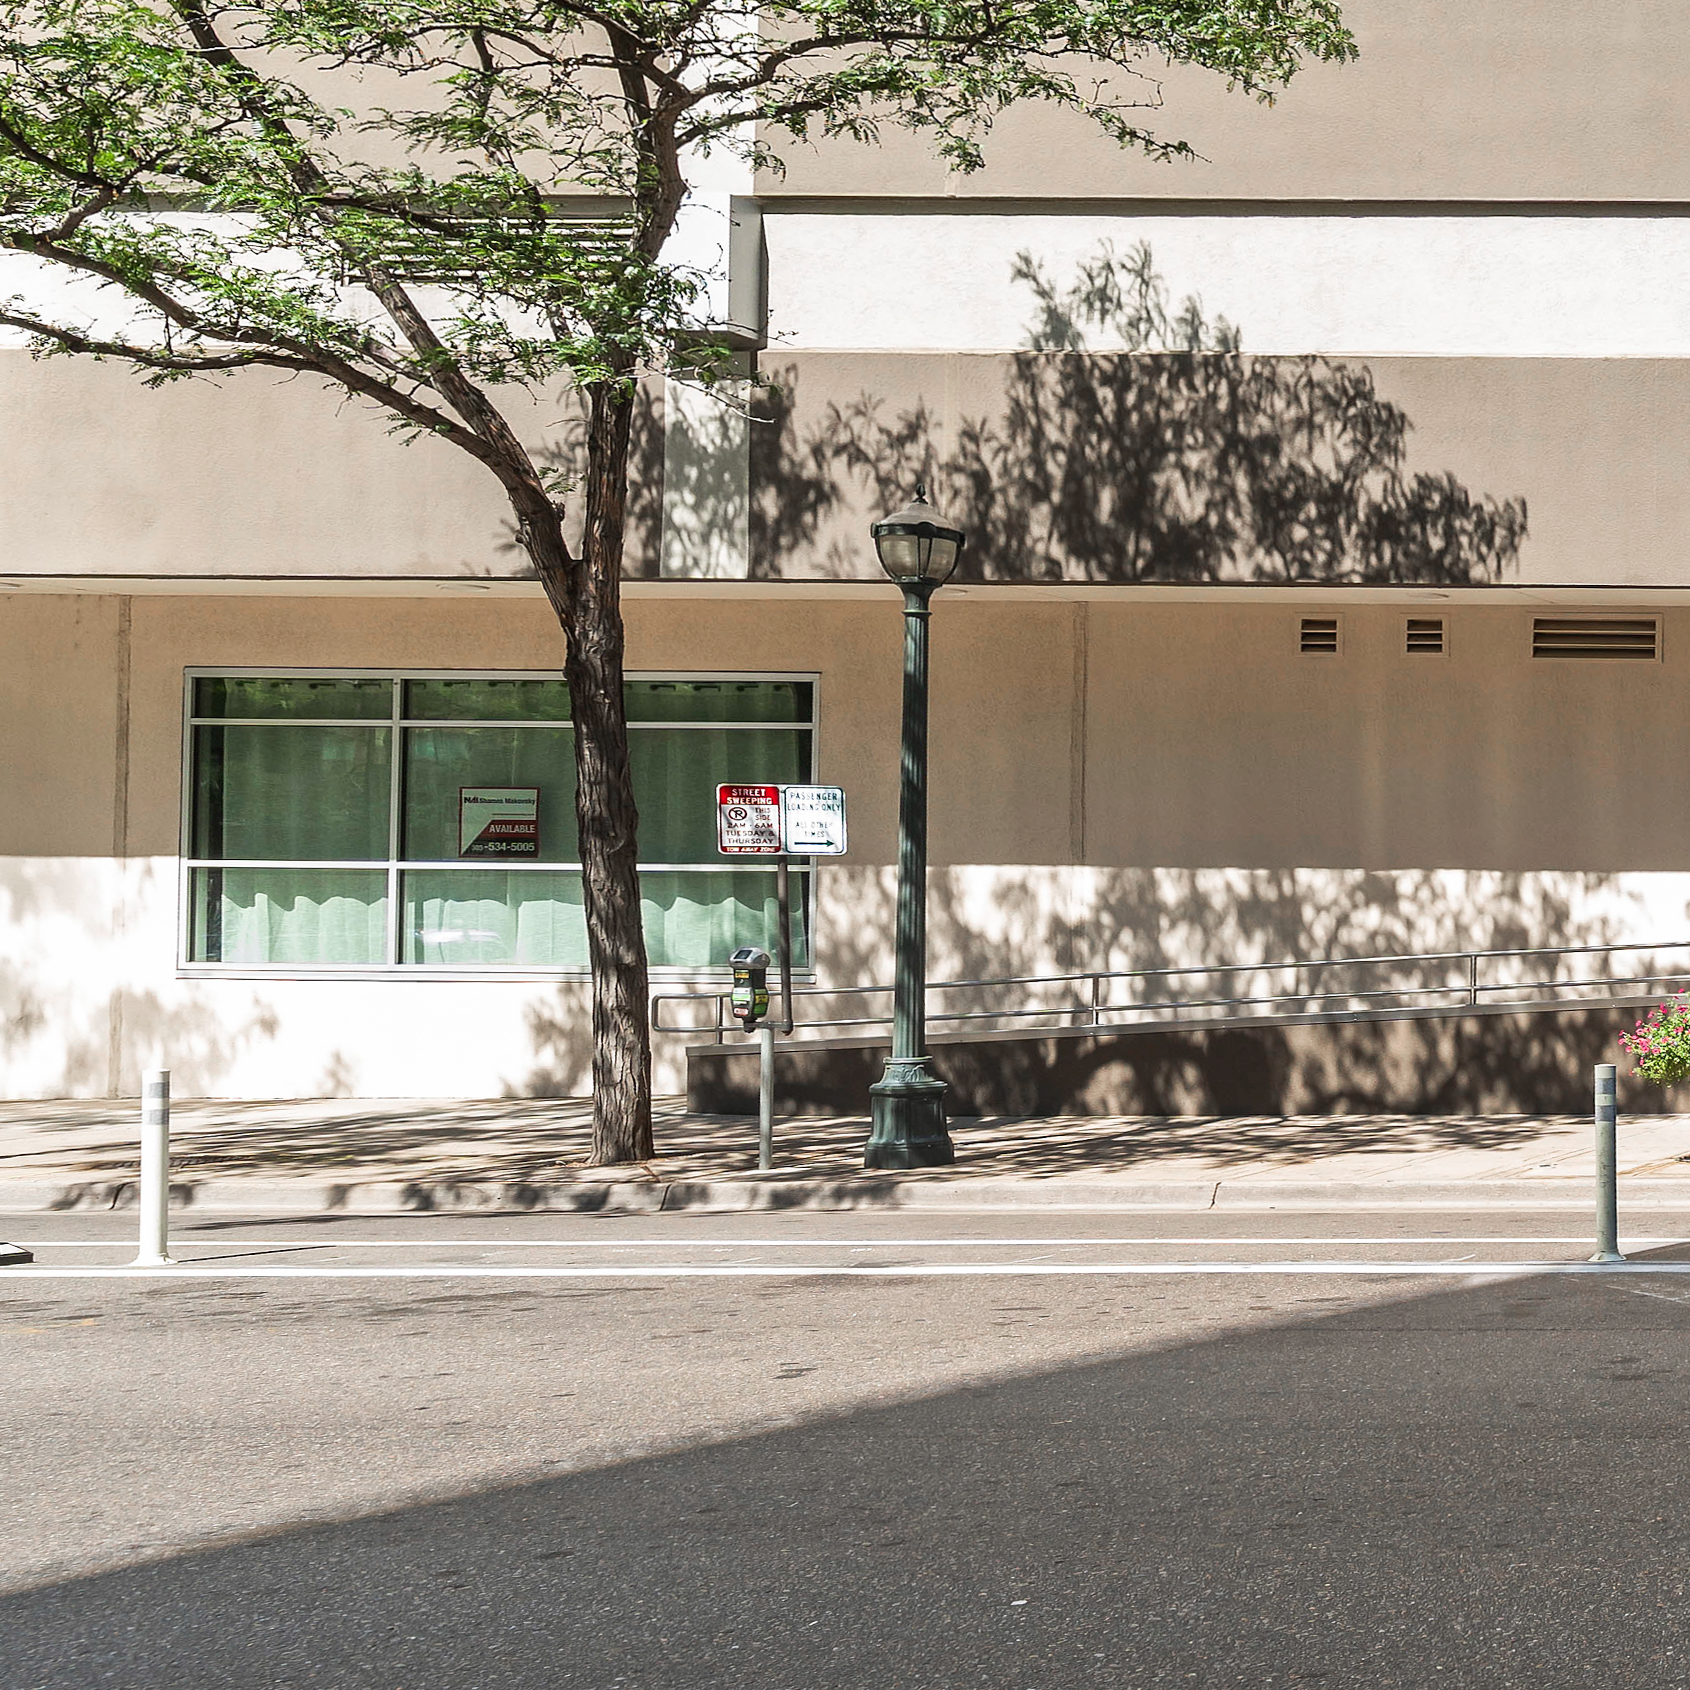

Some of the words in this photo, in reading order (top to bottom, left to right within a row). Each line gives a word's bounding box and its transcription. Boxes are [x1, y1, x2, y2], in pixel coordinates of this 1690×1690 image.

[732, 788, 766, 796] STREET
[790, 792, 838, 801] PASSENGER
[821, 803, 841, 811] ONLY
[488, 824, 536, 833] AVAILABLE
